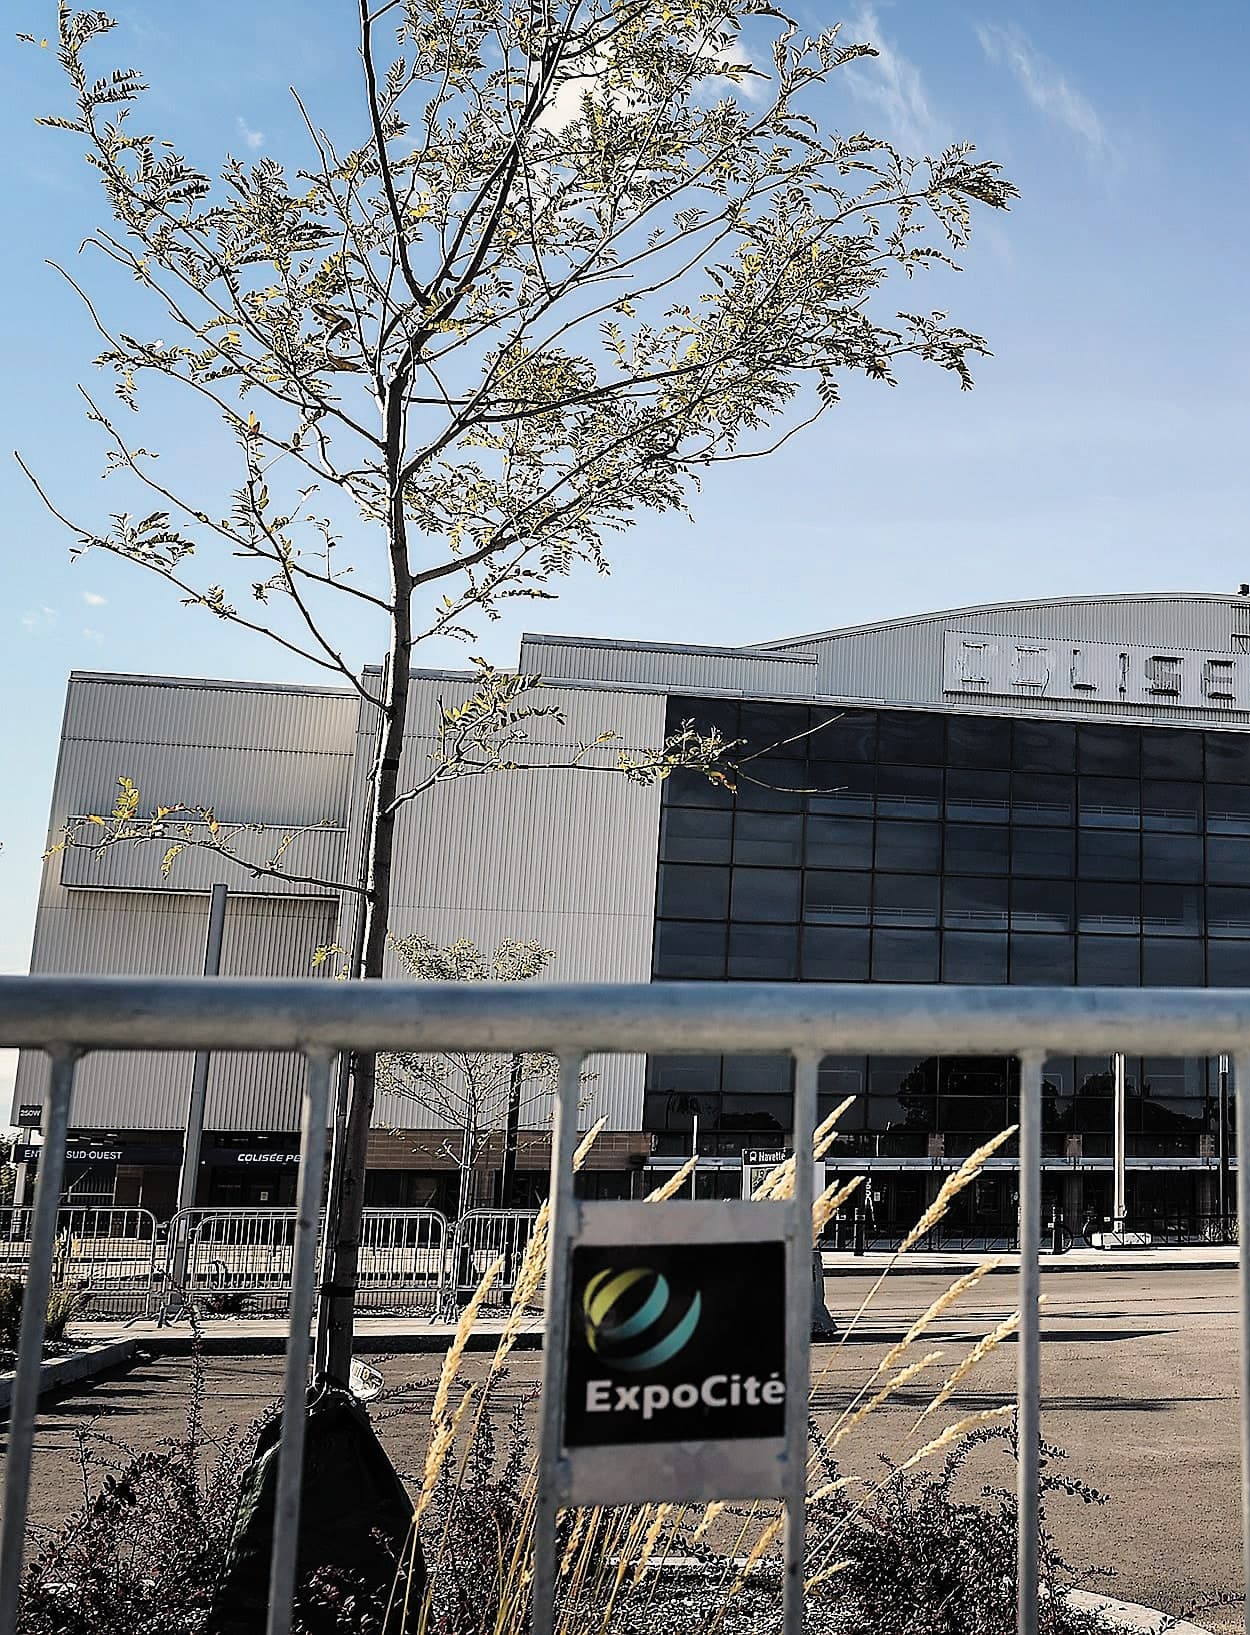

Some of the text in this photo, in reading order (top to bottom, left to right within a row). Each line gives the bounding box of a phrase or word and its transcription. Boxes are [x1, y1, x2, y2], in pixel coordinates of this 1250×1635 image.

[65, 1150, 123, 1160] SUD-OUEST
[237, 1152, 284, 1162] COLISÉE
[585, 1372, 786, 1420] ExpoCité
